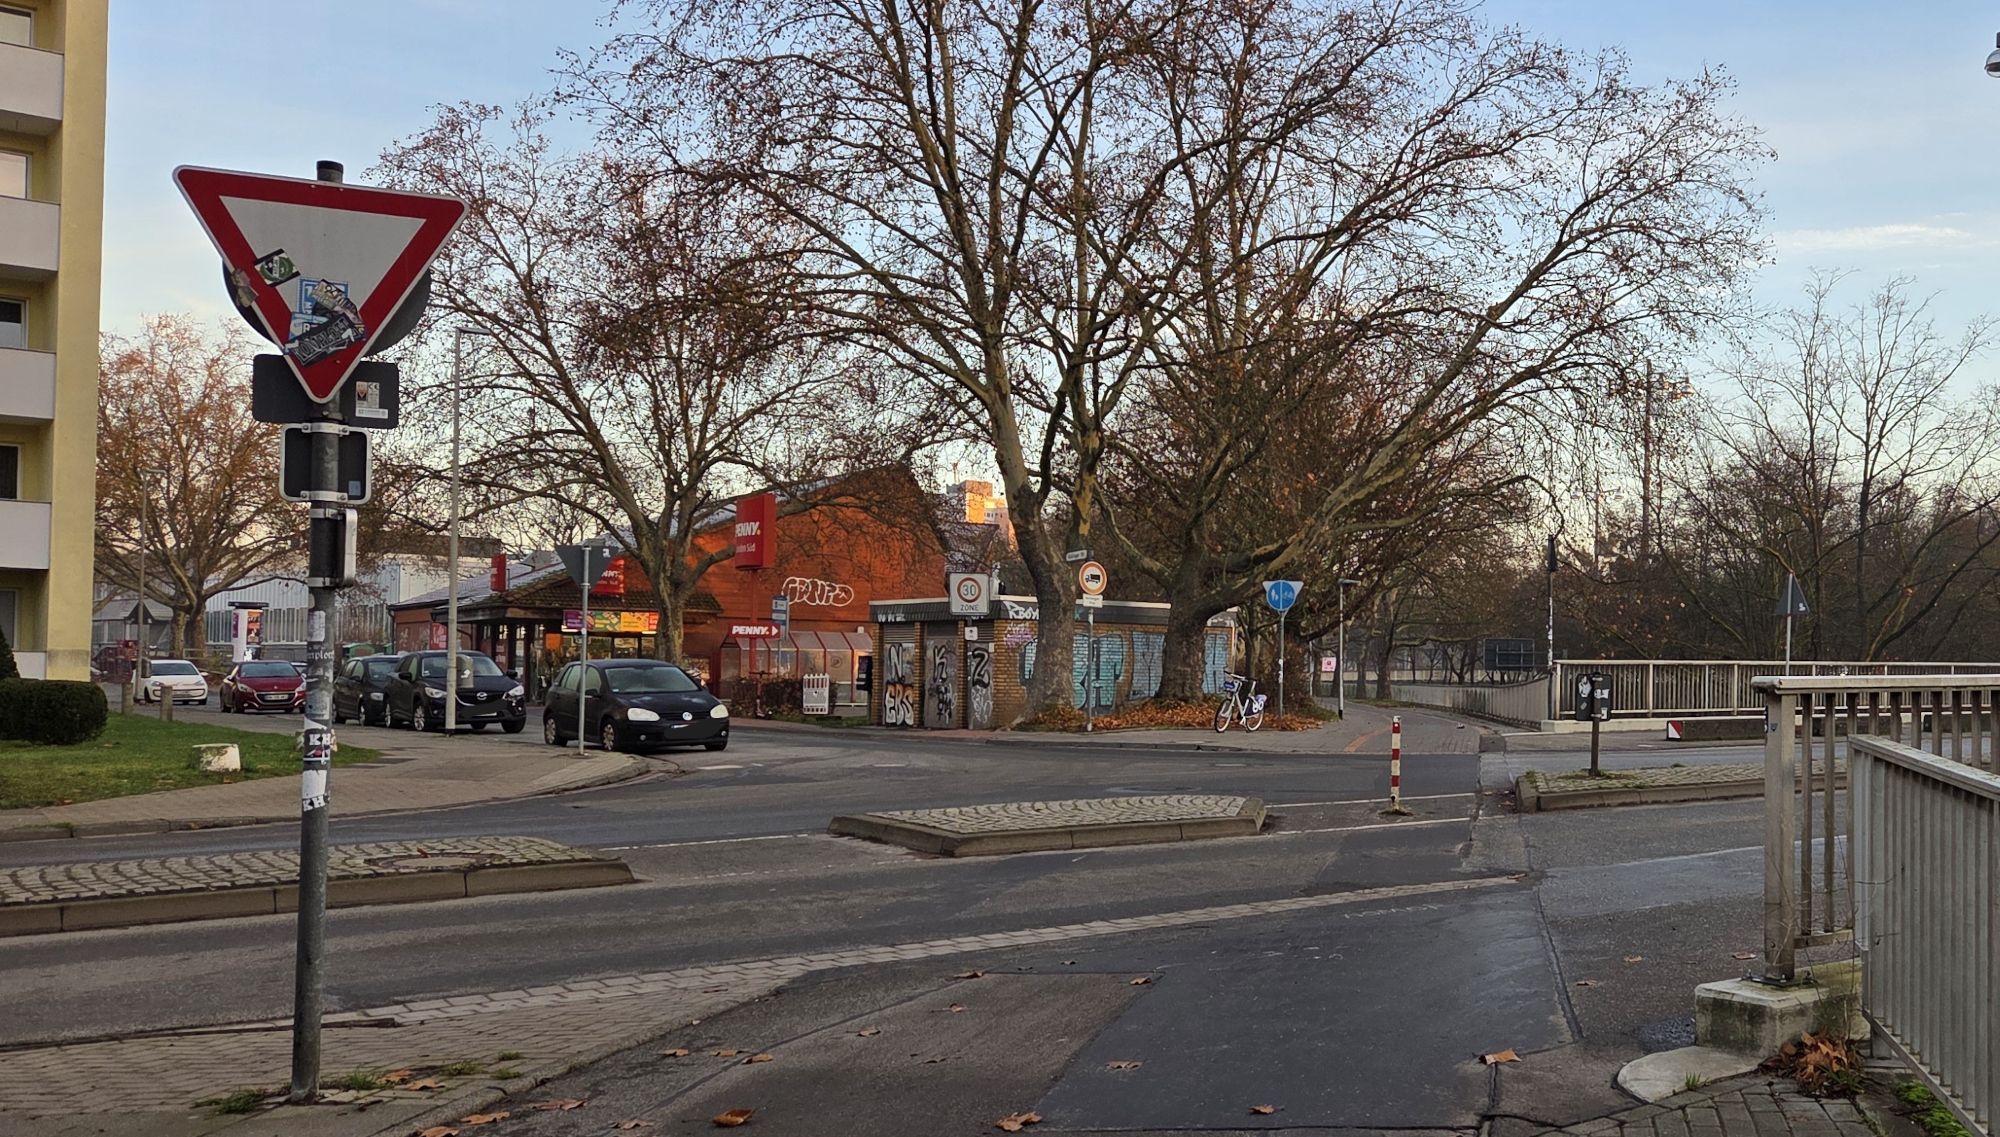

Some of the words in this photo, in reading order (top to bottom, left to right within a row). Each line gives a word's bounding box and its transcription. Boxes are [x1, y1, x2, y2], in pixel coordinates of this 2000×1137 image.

[962, 584, 977, 597] 30
[960, 604, 979, 612] ZONE
[731, 625, 770, 635] PENNY.
